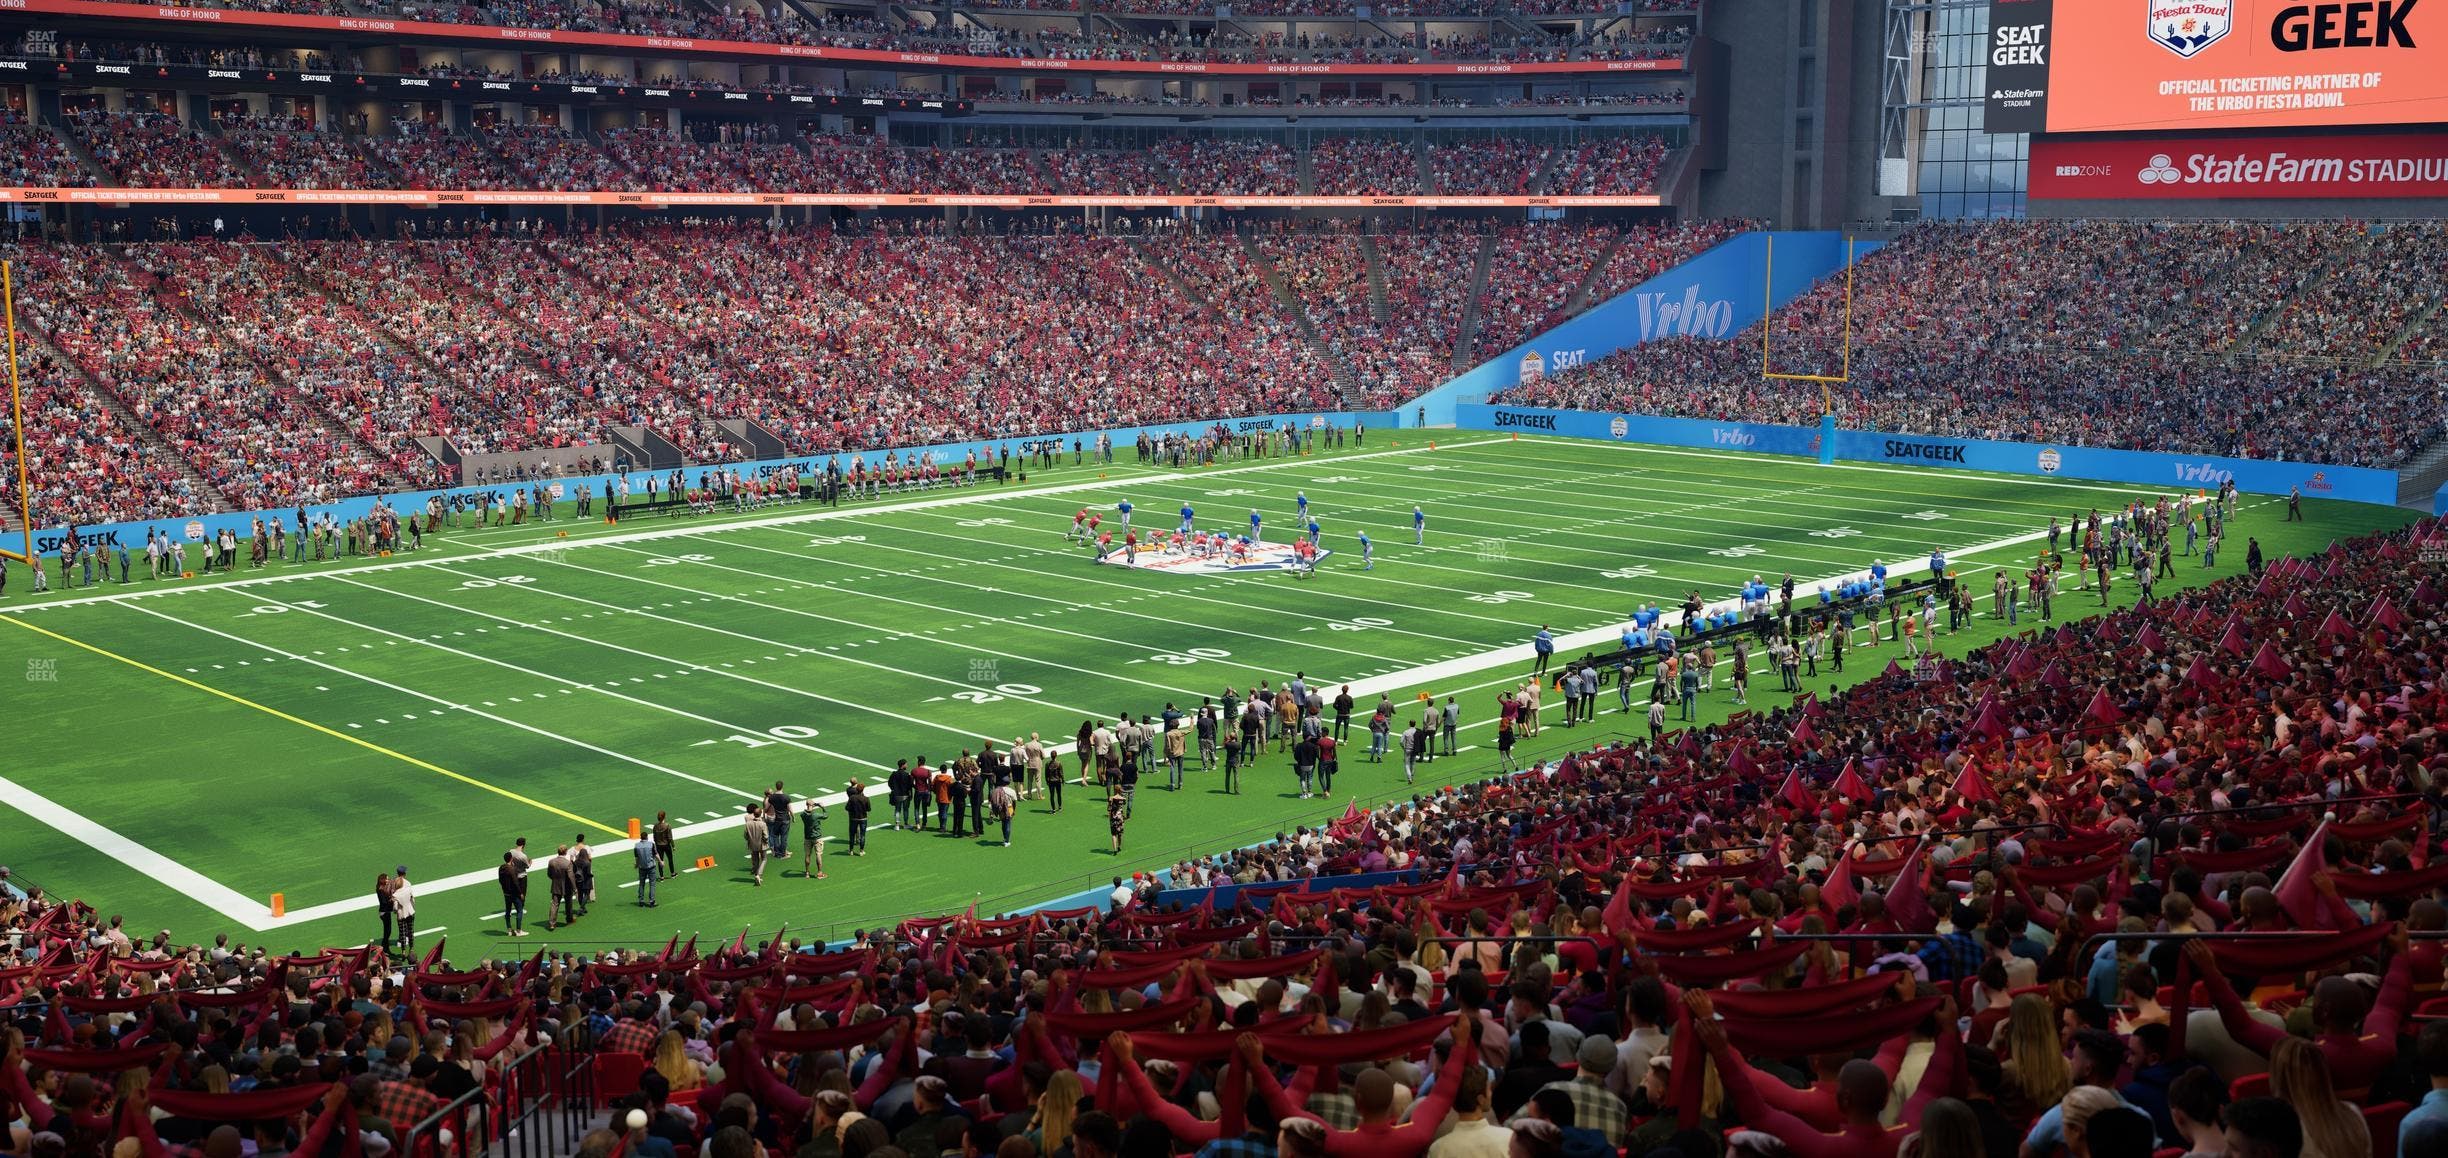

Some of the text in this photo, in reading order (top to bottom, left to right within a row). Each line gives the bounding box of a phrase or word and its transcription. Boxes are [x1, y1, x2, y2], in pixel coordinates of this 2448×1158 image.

[160, 9, 220, 20] RING OF HONOR
[2153, 4, 2227, 21] Fiesta Bowl
[340, 20, 394, 30] RING OF HONOR
[2271, 0, 2418, 52] GEEK
[502, 30, 551, 40] RING OF HONOR
[1996, 24, 2045, 46] SEAT
[648, 38, 693, 48] RING OF HONOR
[780, 46, 793, 54] RING
[1993, 45, 2045, 66] GEEK
[921, 55, 938, 63] HONOR
[1046, 60, 1068, 68] HONOR
[96, 65, 130, 74] SEATGEEK
[1184, 64, 1206, 72] HONOR
[1607, 62, 1622, 70] RING
[208, 70, 240, 79] SEATGEEK
[301, 74, 331, 82] SEATGEEK
[400, 78, 429, 86] SEATGEEK
[483, 82, 510, 90] SEATGEEK
[2159, 72, 2381, 95] OFFICIAL TICKETING PARTNER OF
[571, 86, 597, 94] SEATGEEK
[2190, 92, 2344, 112] THE VRBO FIESTA BOWL
[24, 191, 57, 199] SEATGEEK
[1636, 284, 1732, 341] Vrbo
[1553, 348, 1585, 370] SEAT
[1239, 419, 1273, 432] SEATGEEK
[1494, 410, 1556, 431] SEATGEEK
[1712, 428, 1755, 447] Vrbo
[1885, 440, 1966, 464] SEATGEEK
[2175, 462, 2232, 483] Vrbo
[1600, 566, 1657, 578] 40
[1464, 590, 1535, 604] 50
[1326, 617, 1394, 632] 40
[1150, 648, 1232, 664] 30
[951, 683, 1043, 704] 20
[724, 725, 819, 748] 10
